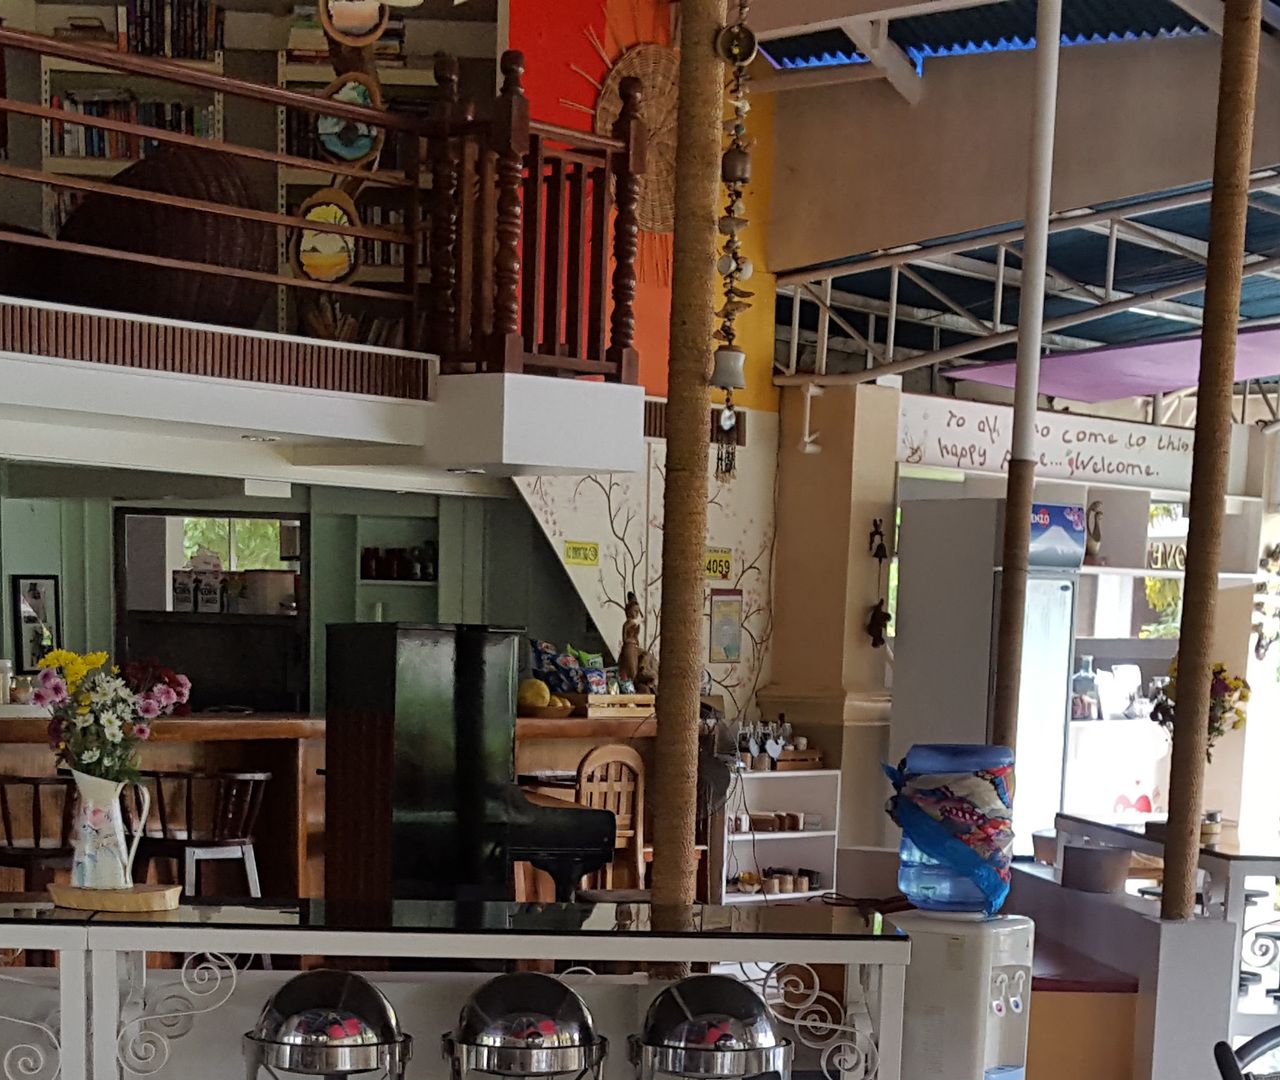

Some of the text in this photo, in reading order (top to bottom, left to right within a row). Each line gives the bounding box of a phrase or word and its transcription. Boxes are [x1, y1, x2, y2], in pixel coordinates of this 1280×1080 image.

[938, 437, 987, 467] happy
[1061, 430, 1118, 445] come
[1157, 434, 1190, 452] this
[706, 558, 730, 574] 4059
